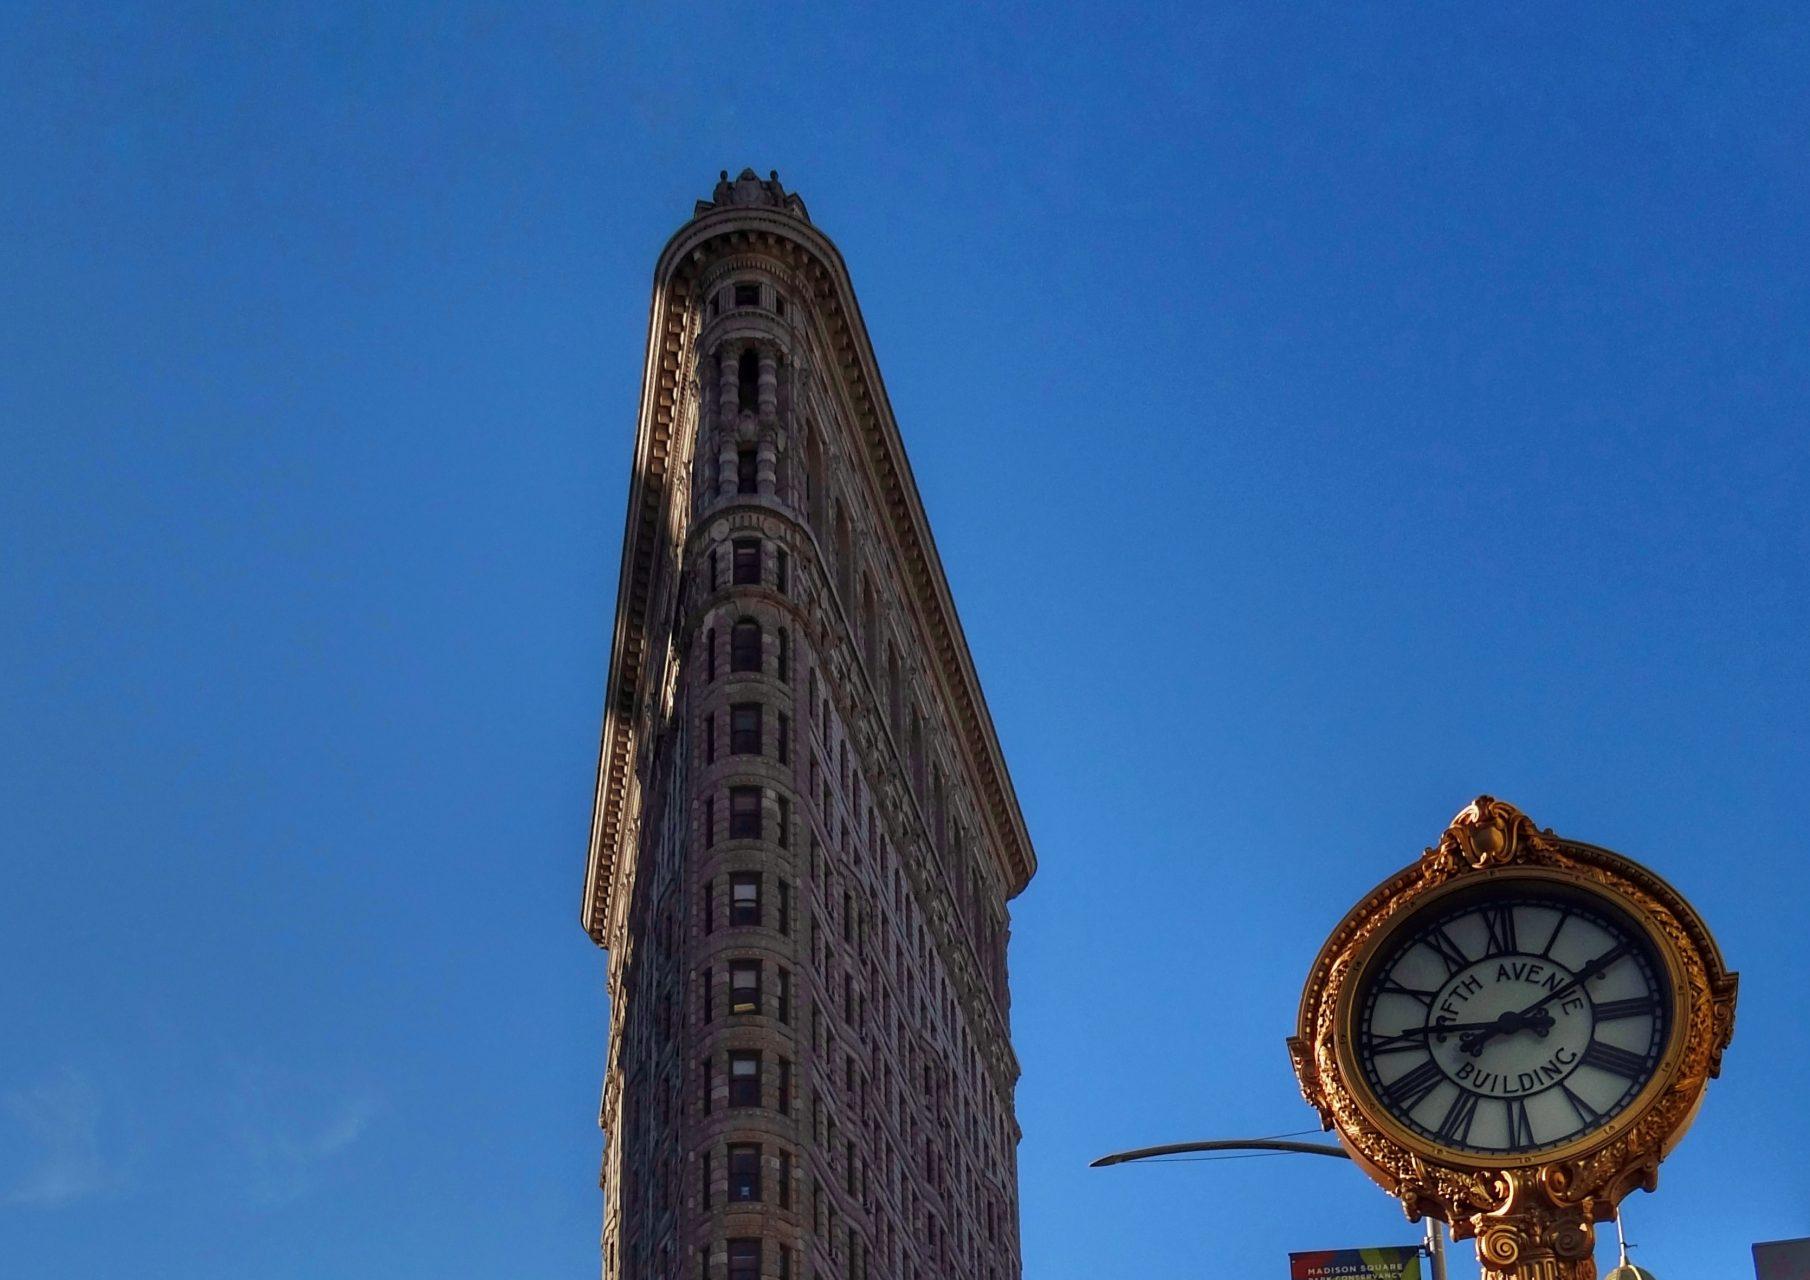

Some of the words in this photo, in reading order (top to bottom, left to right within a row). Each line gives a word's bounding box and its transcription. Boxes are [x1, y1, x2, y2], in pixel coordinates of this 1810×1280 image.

[1437, 974, 1483, 1025] IFTH
[1455, 1047, 1577, 1094] BUILDING
[1307, 1265, 1357, 1275] MADISON
[1360, 1263, 1403, 1272] SQUARE
